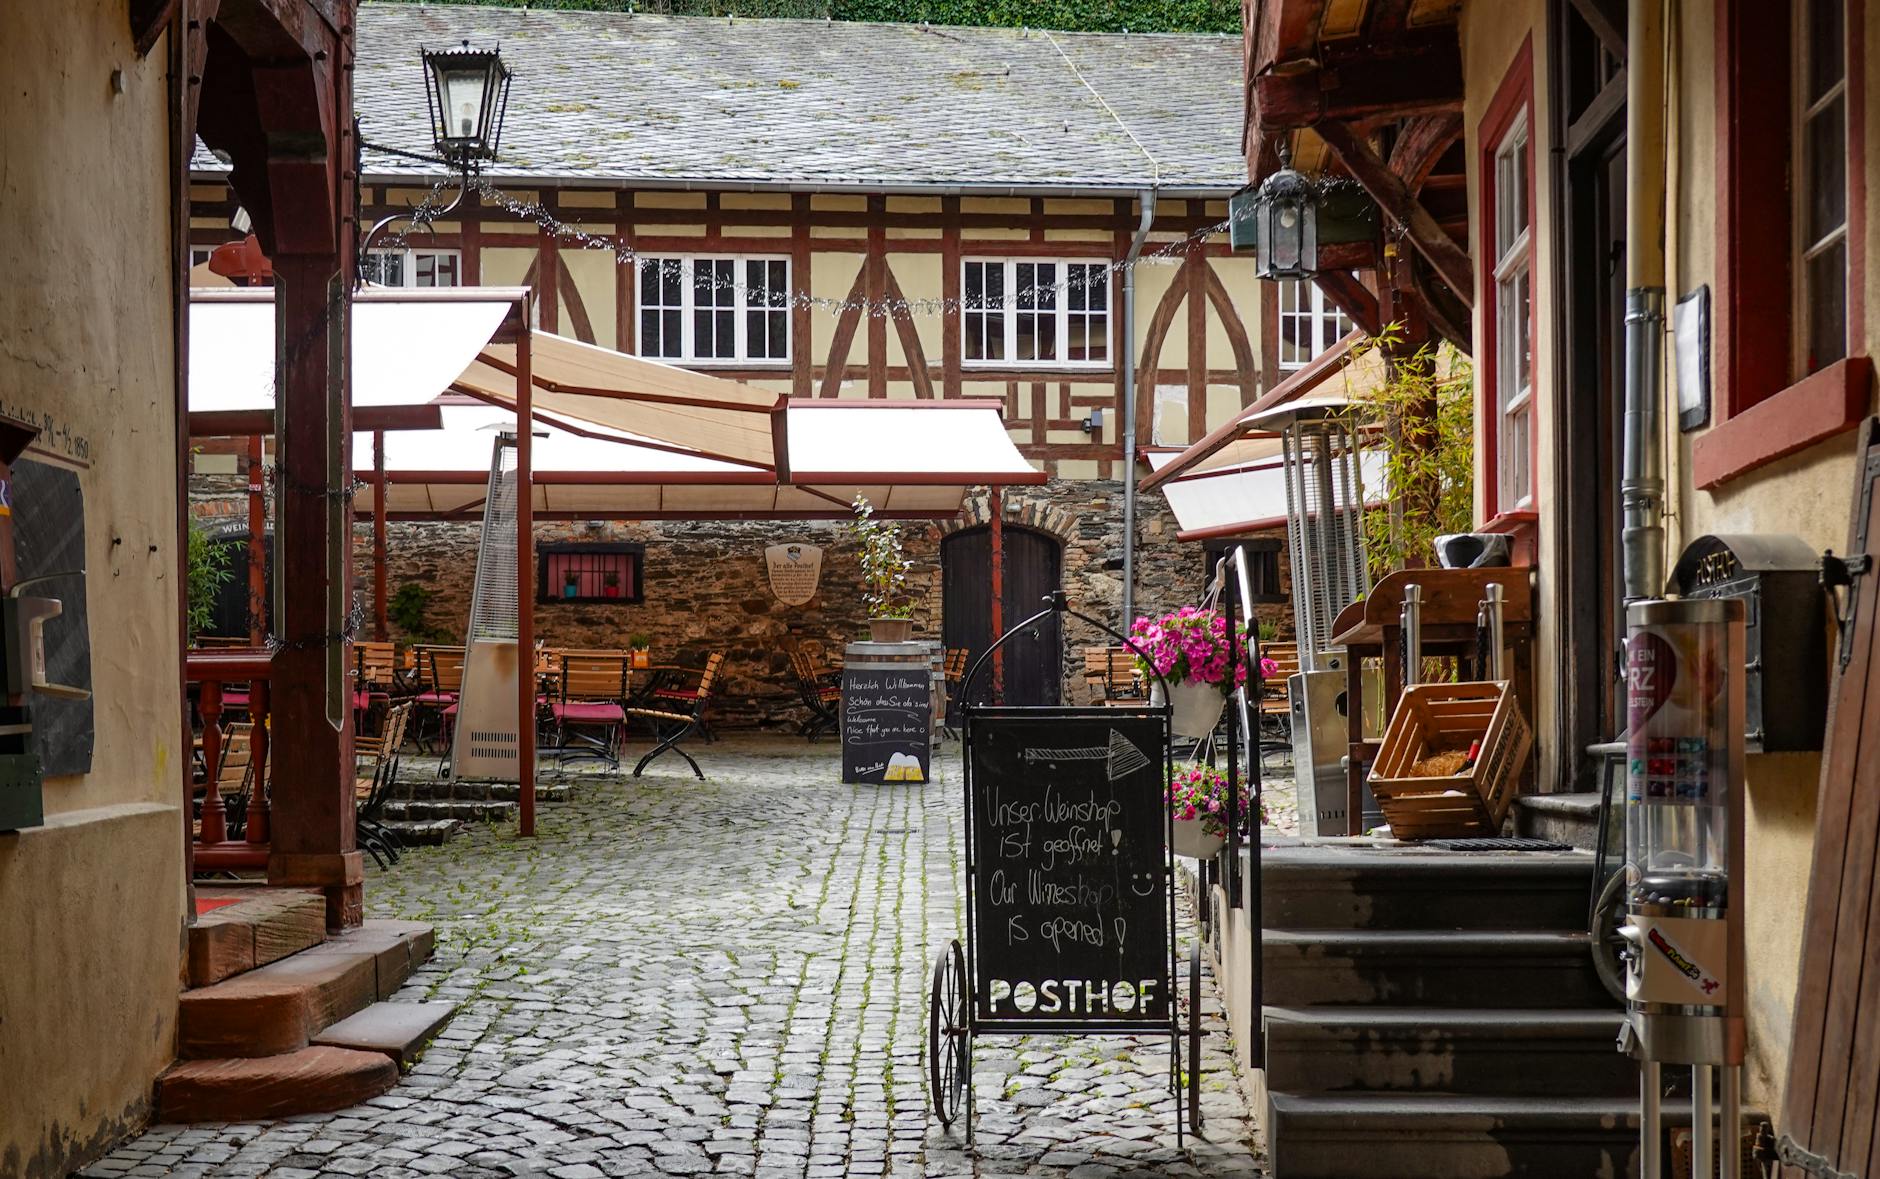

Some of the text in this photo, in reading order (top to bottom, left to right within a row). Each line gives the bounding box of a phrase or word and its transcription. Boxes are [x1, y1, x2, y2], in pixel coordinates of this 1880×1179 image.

[1638, 649, 1655, 661] EIN
[849, 677, 879, 691] Herzlich
[848, 695, 872, 707] Schön
[902, 723, 917, 733] here
[1044, 784, 1121, 833] Weinshop
[990, 869, 1017, 905] Our
[1041, 914, 1103, 953] opened
[989, 979, 1158, 1013] POSTHOF
